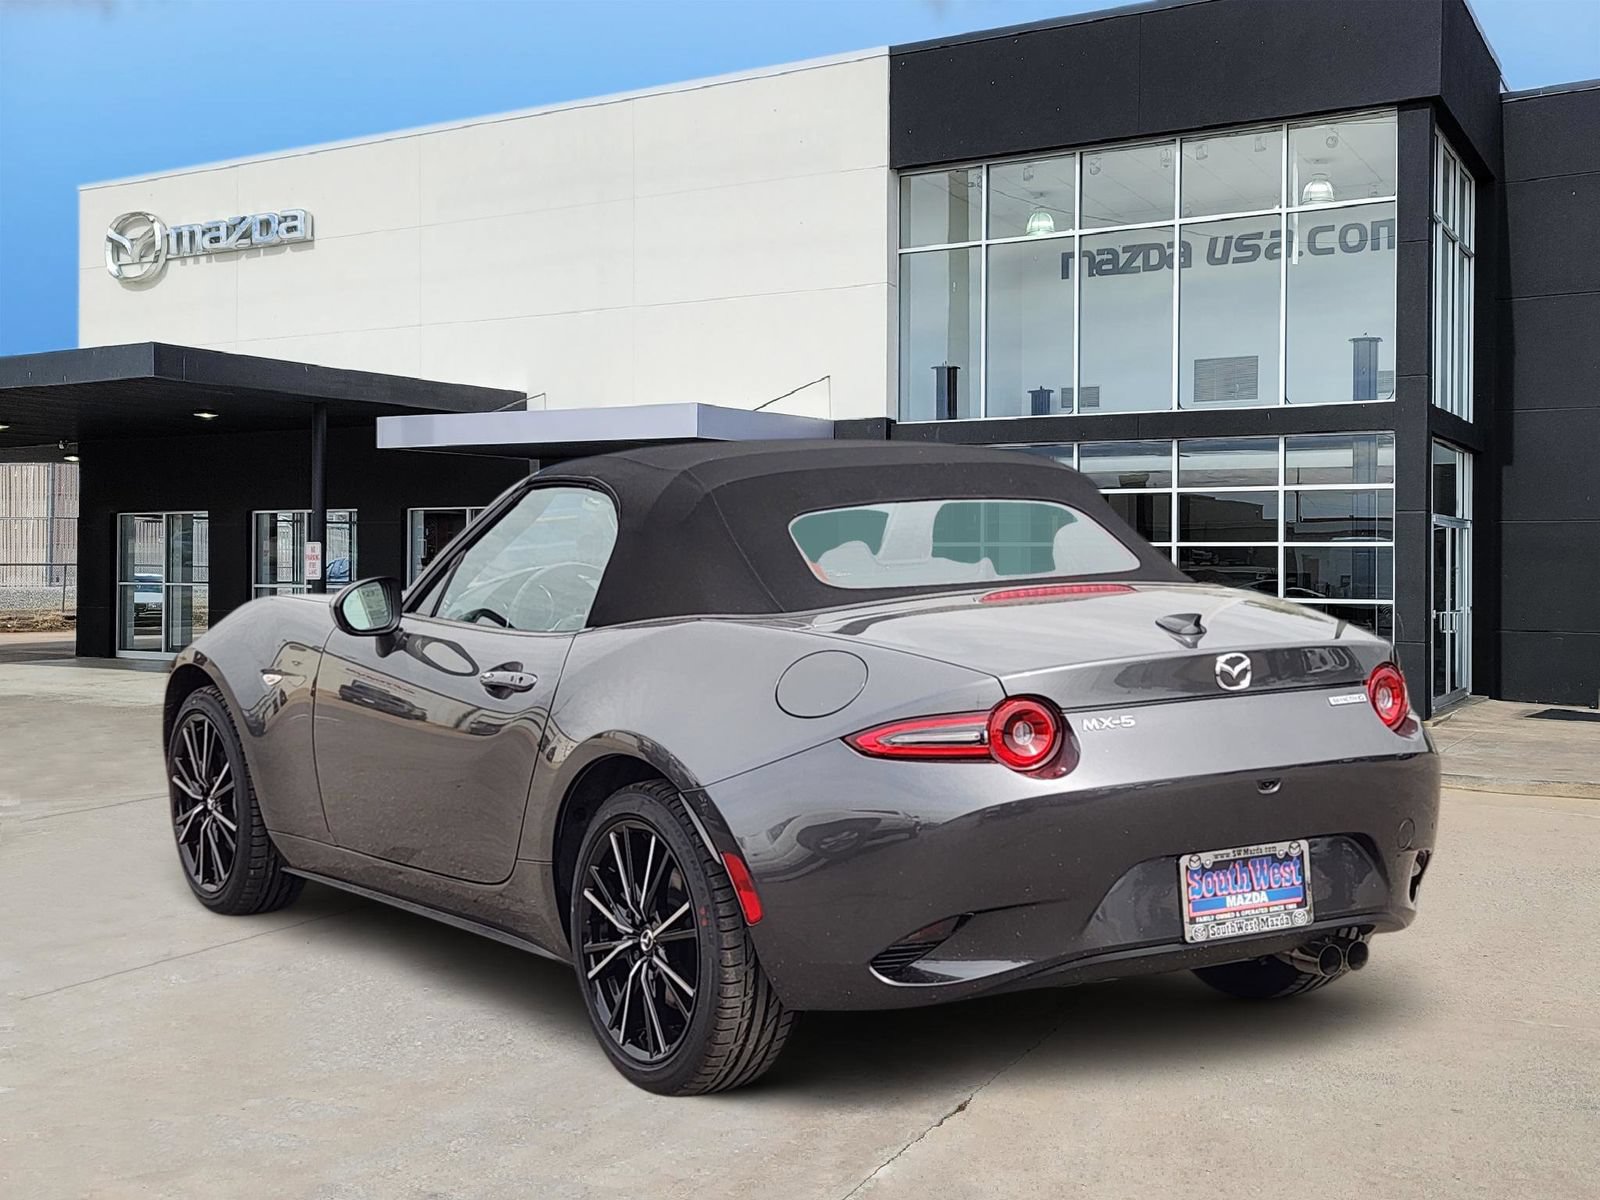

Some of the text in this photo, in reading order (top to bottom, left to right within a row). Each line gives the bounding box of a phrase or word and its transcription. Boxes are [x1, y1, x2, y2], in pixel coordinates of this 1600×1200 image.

[1082, 715, 1136, 731] MX-5
[1188, 856, 1303, 900] SouthWest
[1226, 891, 1270, 908] MAZDA
[1260, 914, 1291, 930] Mazda
